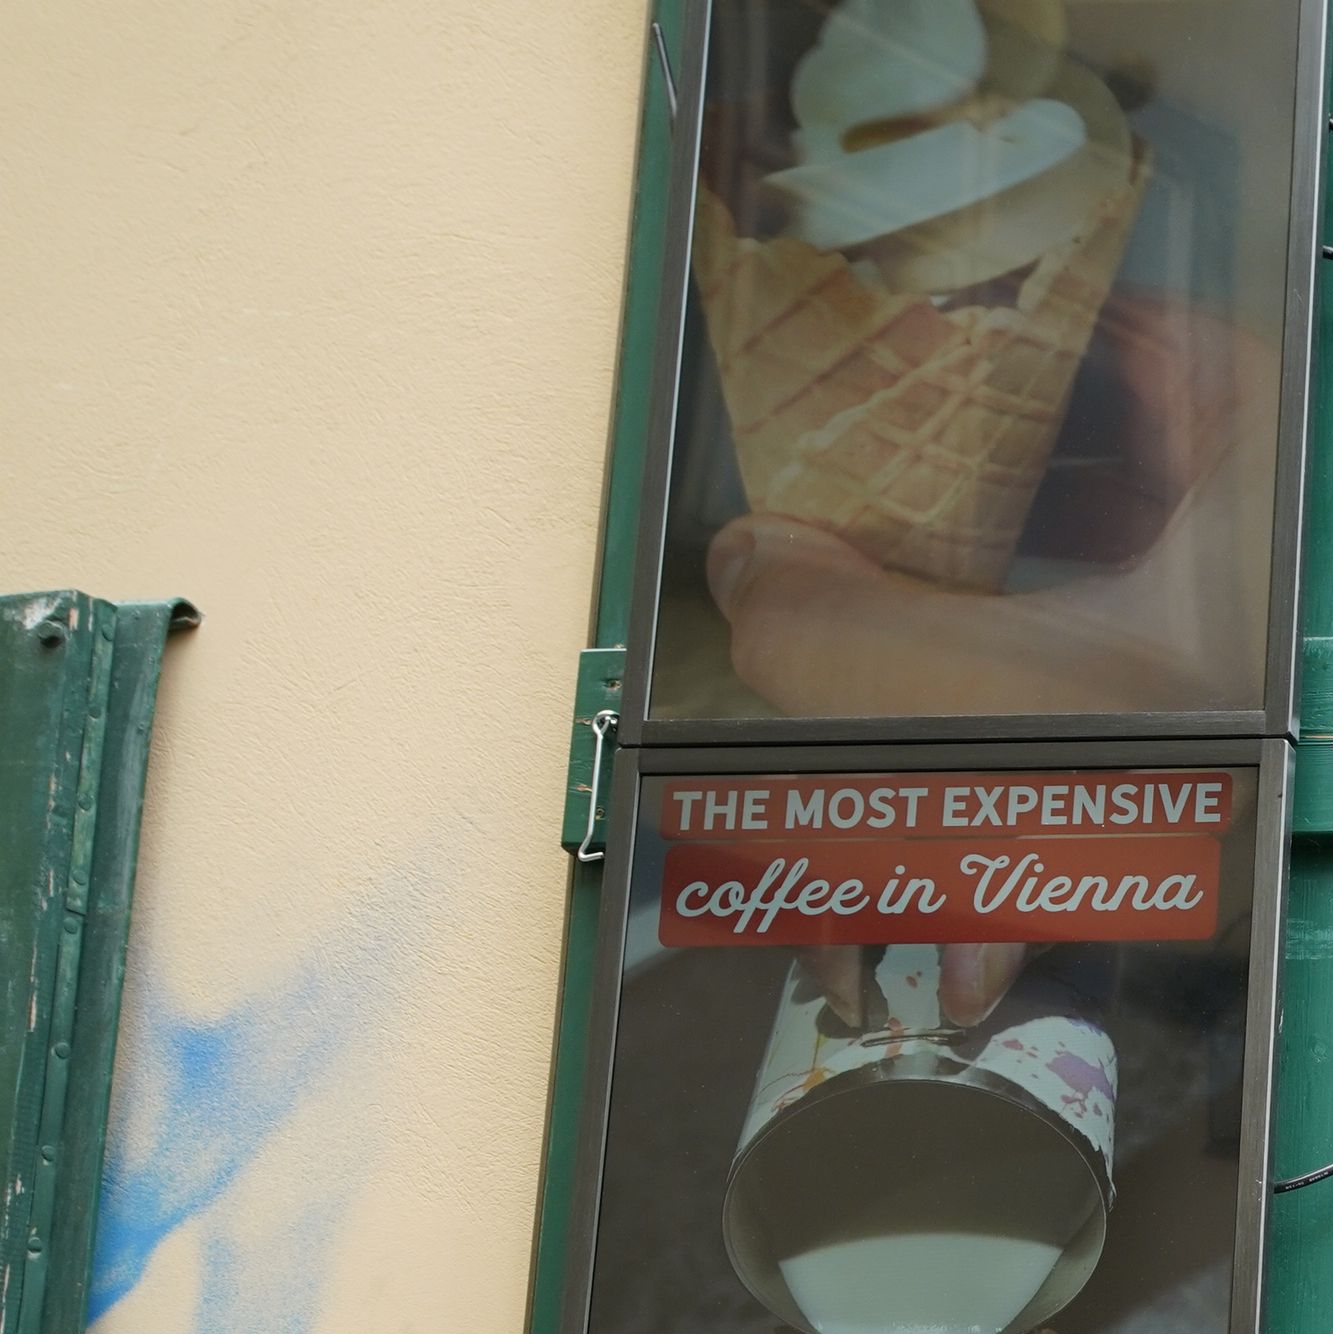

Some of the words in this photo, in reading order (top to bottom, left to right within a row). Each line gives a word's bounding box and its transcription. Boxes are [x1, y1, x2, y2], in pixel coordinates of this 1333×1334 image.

[672, 789, 770, 832] THE
[785, 787, 929, 831] MOST
[941, 782, 1224, 828] EXPENSIVE
[675, 857, 871, 934] coffee
[876, 864, 947, 916] in
[959, 851, 1206, 916] Vienna
